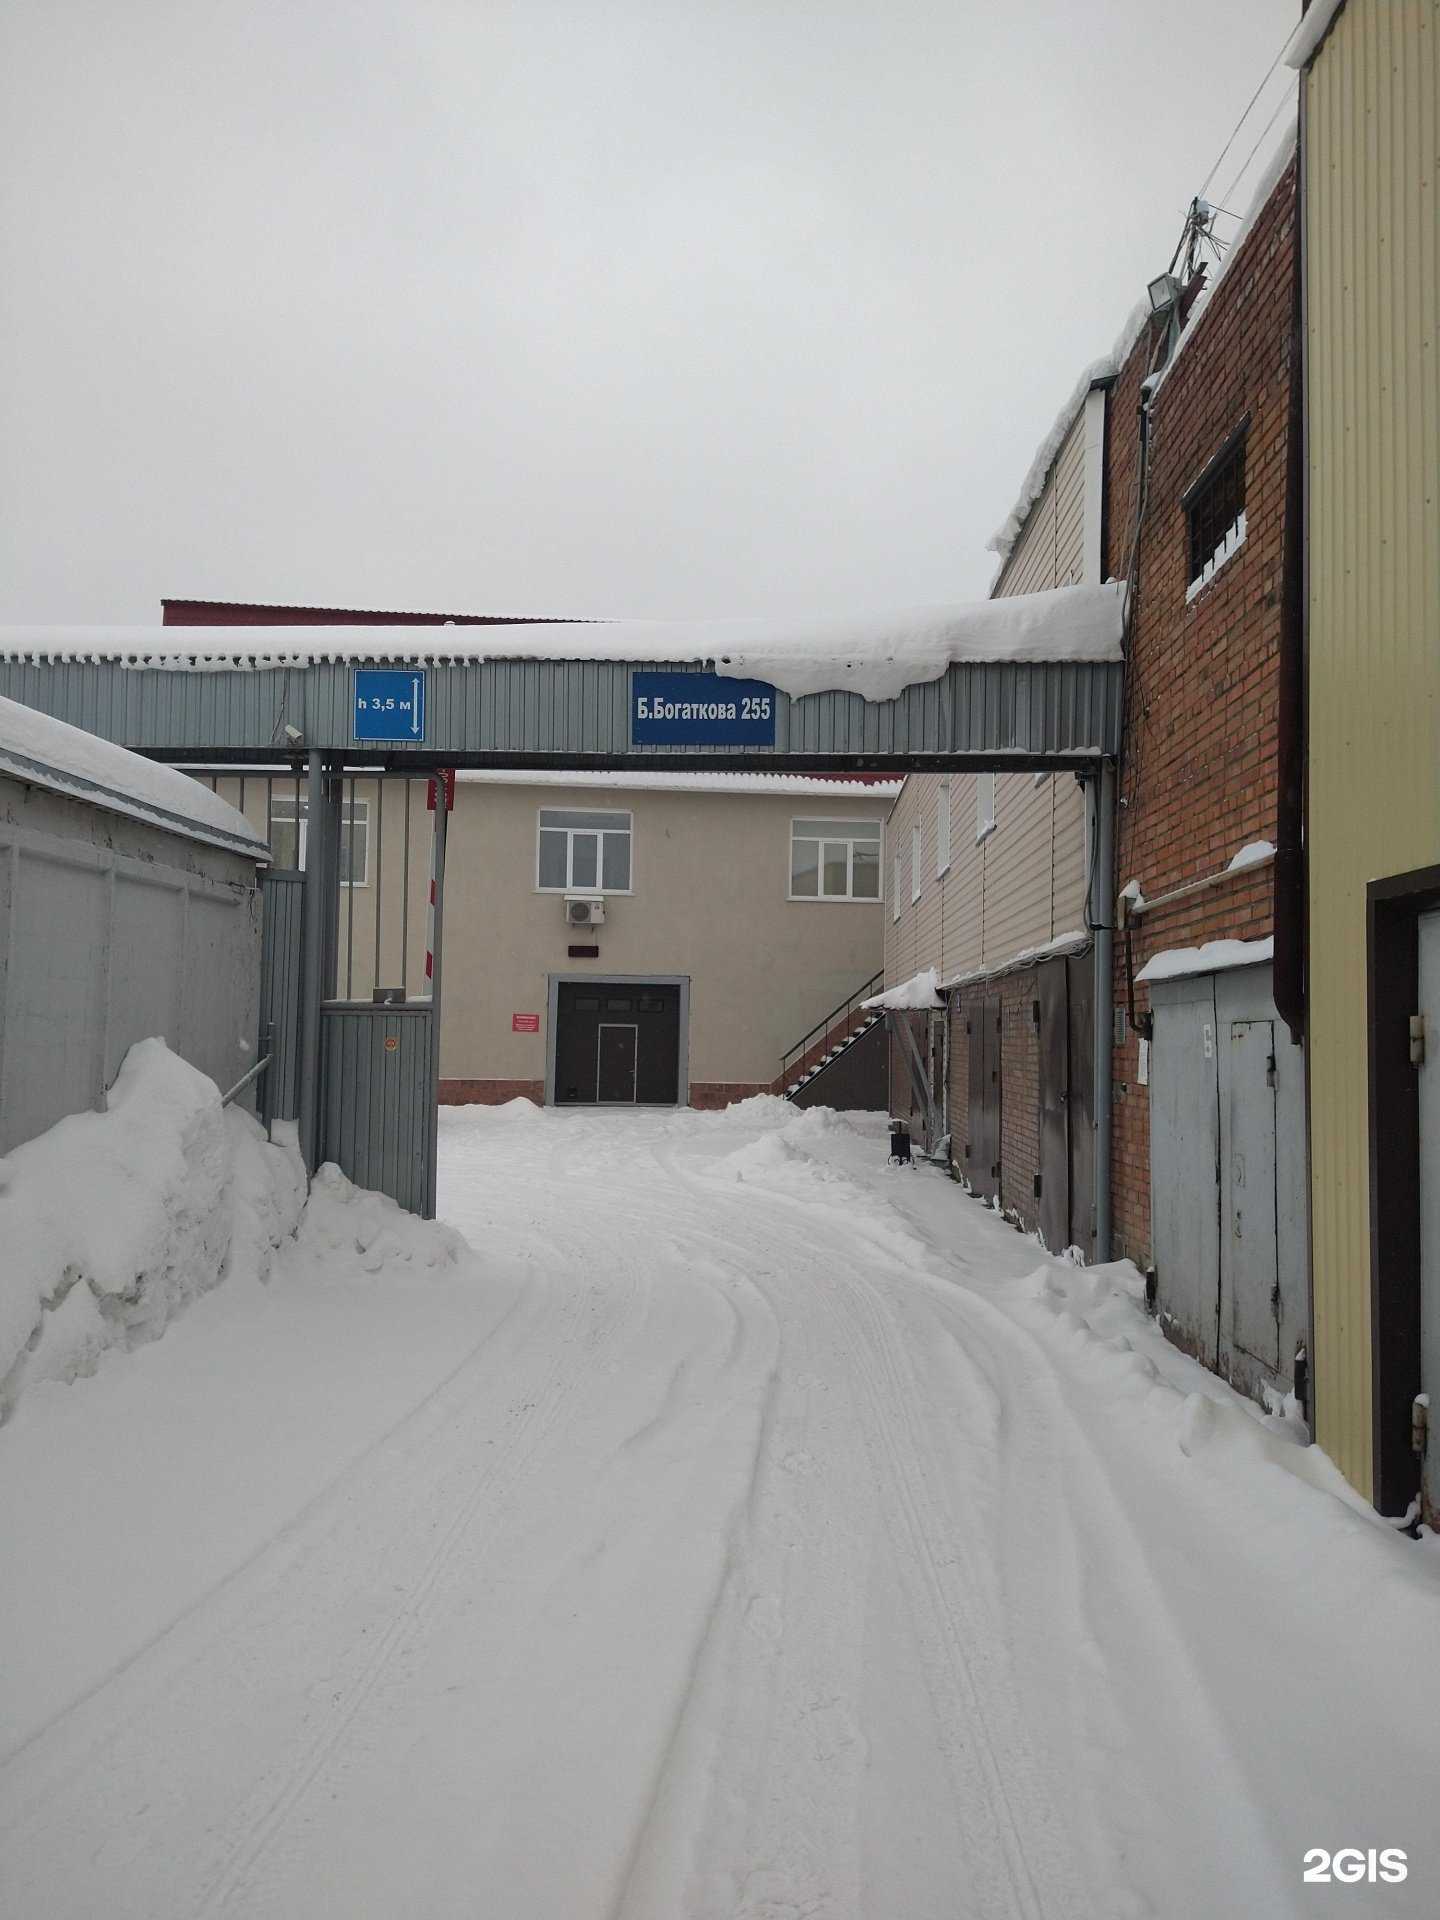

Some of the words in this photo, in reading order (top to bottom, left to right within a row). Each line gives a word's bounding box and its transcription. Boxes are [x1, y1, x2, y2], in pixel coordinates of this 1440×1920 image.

[358, 697, 367, 709] h
[371, 698, 395, 712] 3,5
[637, 697, 736, 720] Б.Богаткова
[741, 697, 771, 720] 255
